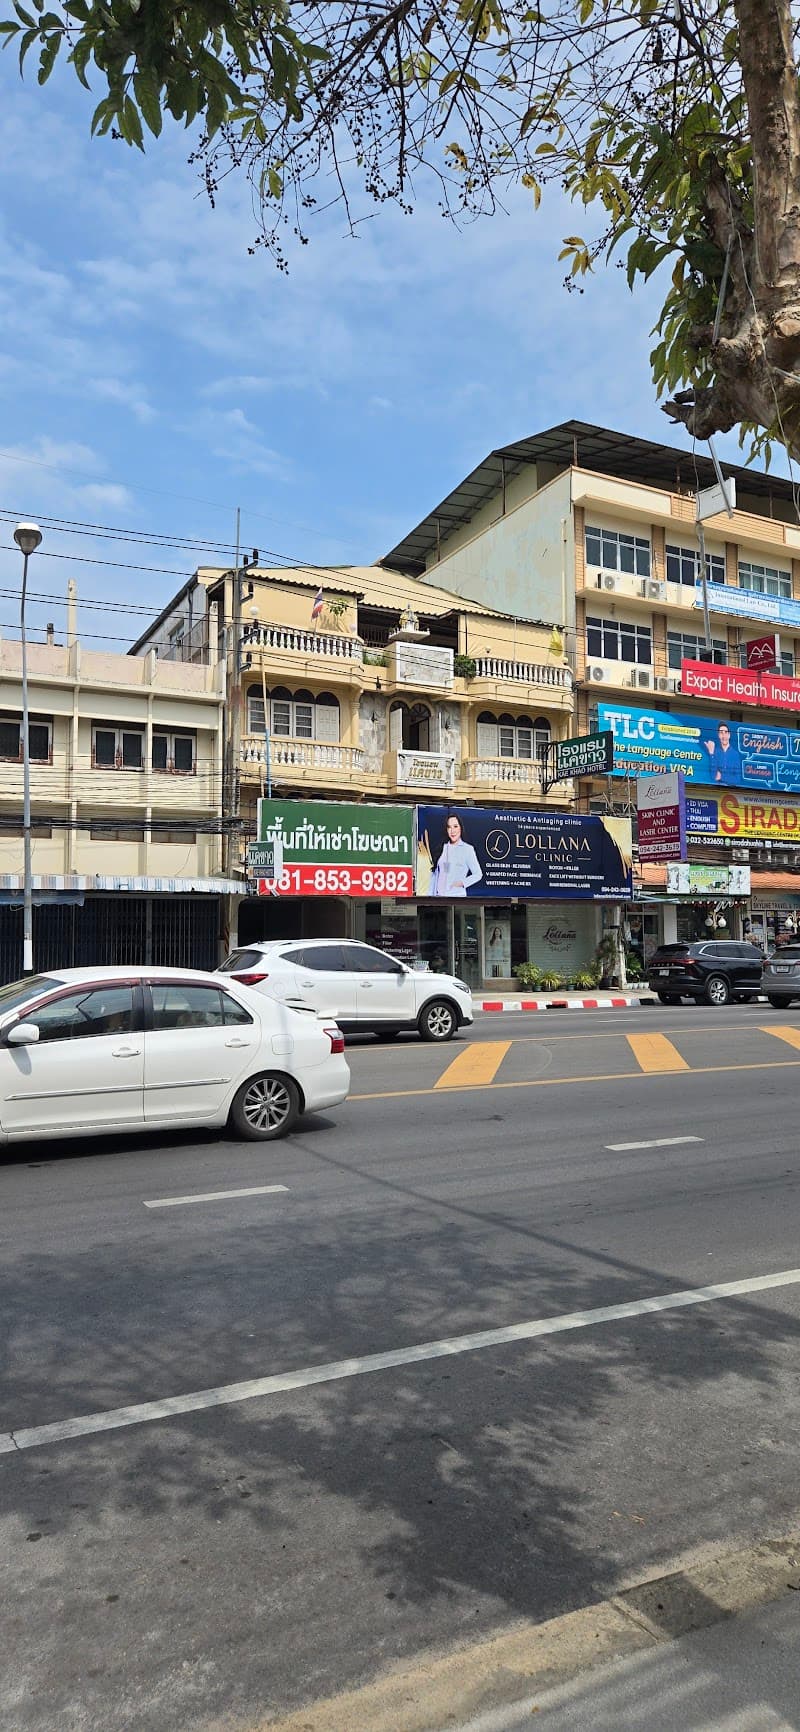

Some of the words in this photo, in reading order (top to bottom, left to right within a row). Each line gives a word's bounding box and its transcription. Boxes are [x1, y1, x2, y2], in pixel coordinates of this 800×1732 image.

[686, 670, 723, 691] Expat
[727, 678, 767, 698] Health
[604, 711, 655, 740] TLC
[558, 738, 606, 757] โรงแรม
[613, 741, 625, 752] he
[627, 743, 672, 759] Language
[673, 749, 702, 760] Centre
[742, 733, 784, 753] English
[558, 750, 606, 769] แคขาว
[587, 764, 606, 773] HOTEL
[613, 758, 666, 773] ducation
[669, 763, 694, 776] VISA
[494, 814, 526, 823] Aesthetic
[533, 817, 564, 826] Antiaging
[564, 818, 582, 826] clinic
[652, 818, 666, 826] AND
[656, 808, 675, 817] CLINIC
[720, 793, 800, 834] SIRAD
[266, 816, 408, 852] พื้นที่ให้เช่าโฆษณา
[640, 828, 655, 837] LASER
[657, 825, 679, 835] CENTER
[515, 833, 591, 852] LOLLANA
[535, 852, 573, 863] CLINIC
[265, 869, 408, 892] 081-853-9382
[543, 925, 577, 945] Lollana
